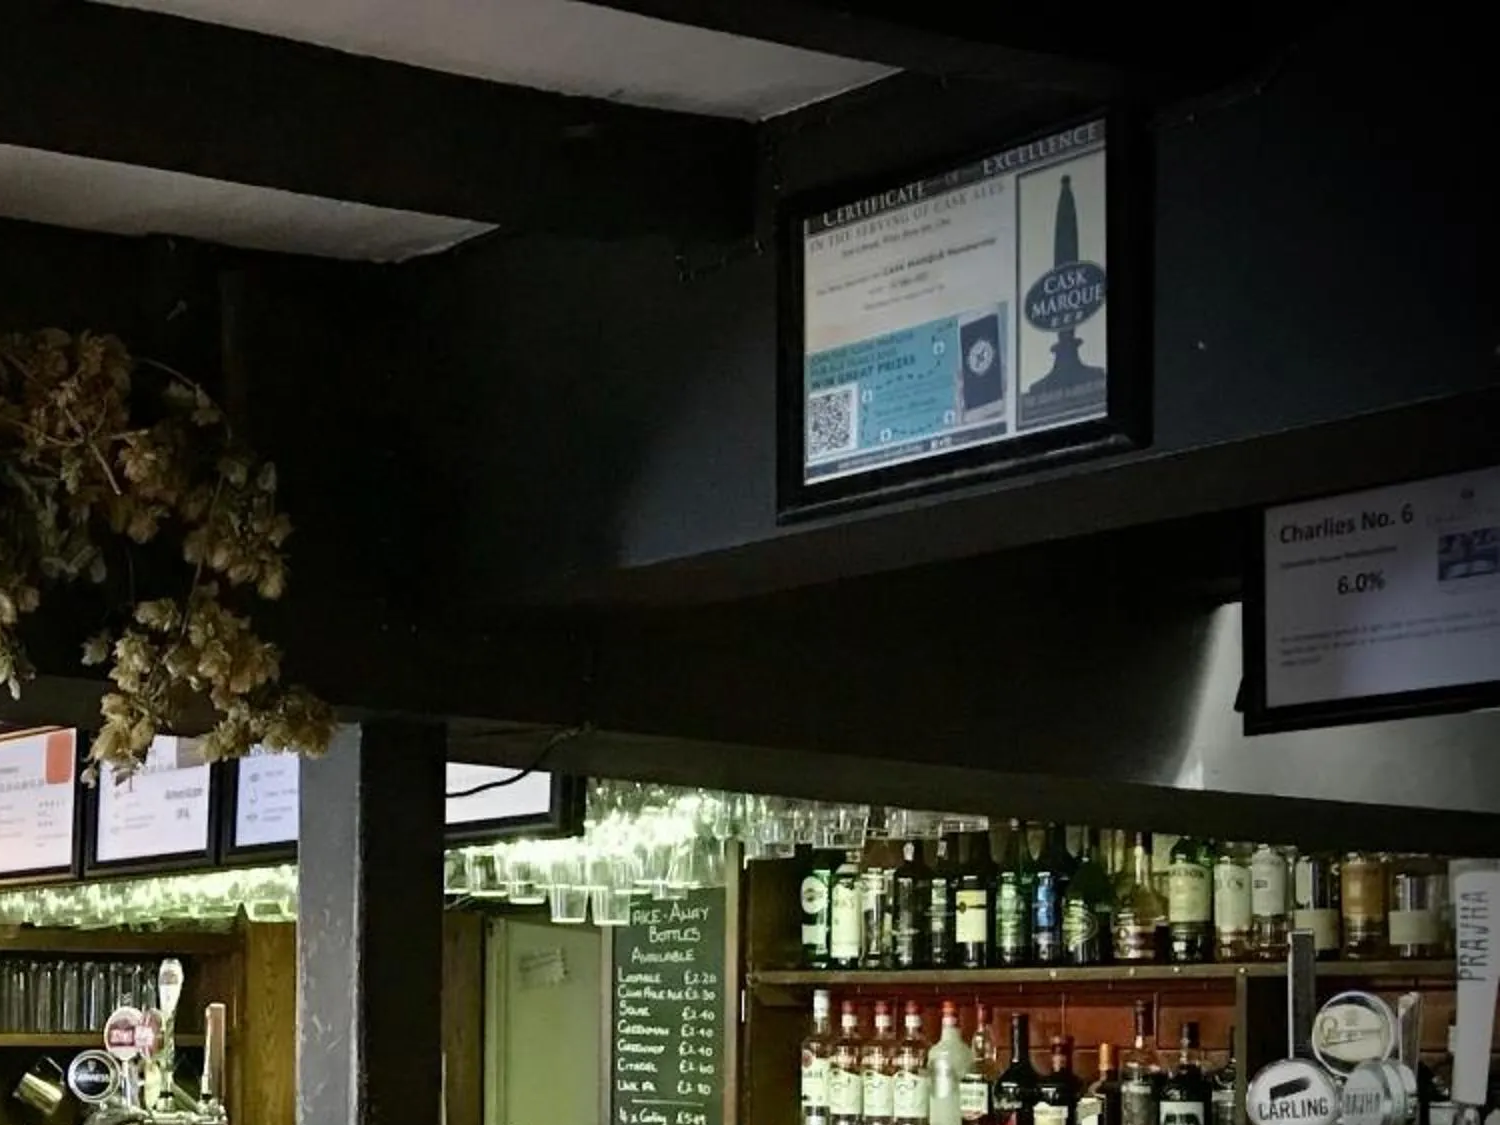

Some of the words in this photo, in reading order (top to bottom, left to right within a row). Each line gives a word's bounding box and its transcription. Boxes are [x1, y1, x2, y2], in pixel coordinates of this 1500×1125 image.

[822, 180, 925, 227] CERTIFICATE
[982, 122, 1098, 176] EXCELLENCE
[1043, 268, 1088, 294] CASK
[1031, 283, 1103, 319] MARQUE
[1279, 516, 1355, 544] Charlies
[1361, 510, 1396, 531] No.
[1401, 503, 1414, 524] 6
[1337, 570, 1386, 595] 6.0%
[1258, 1097, 1329, 1121] CARLING
